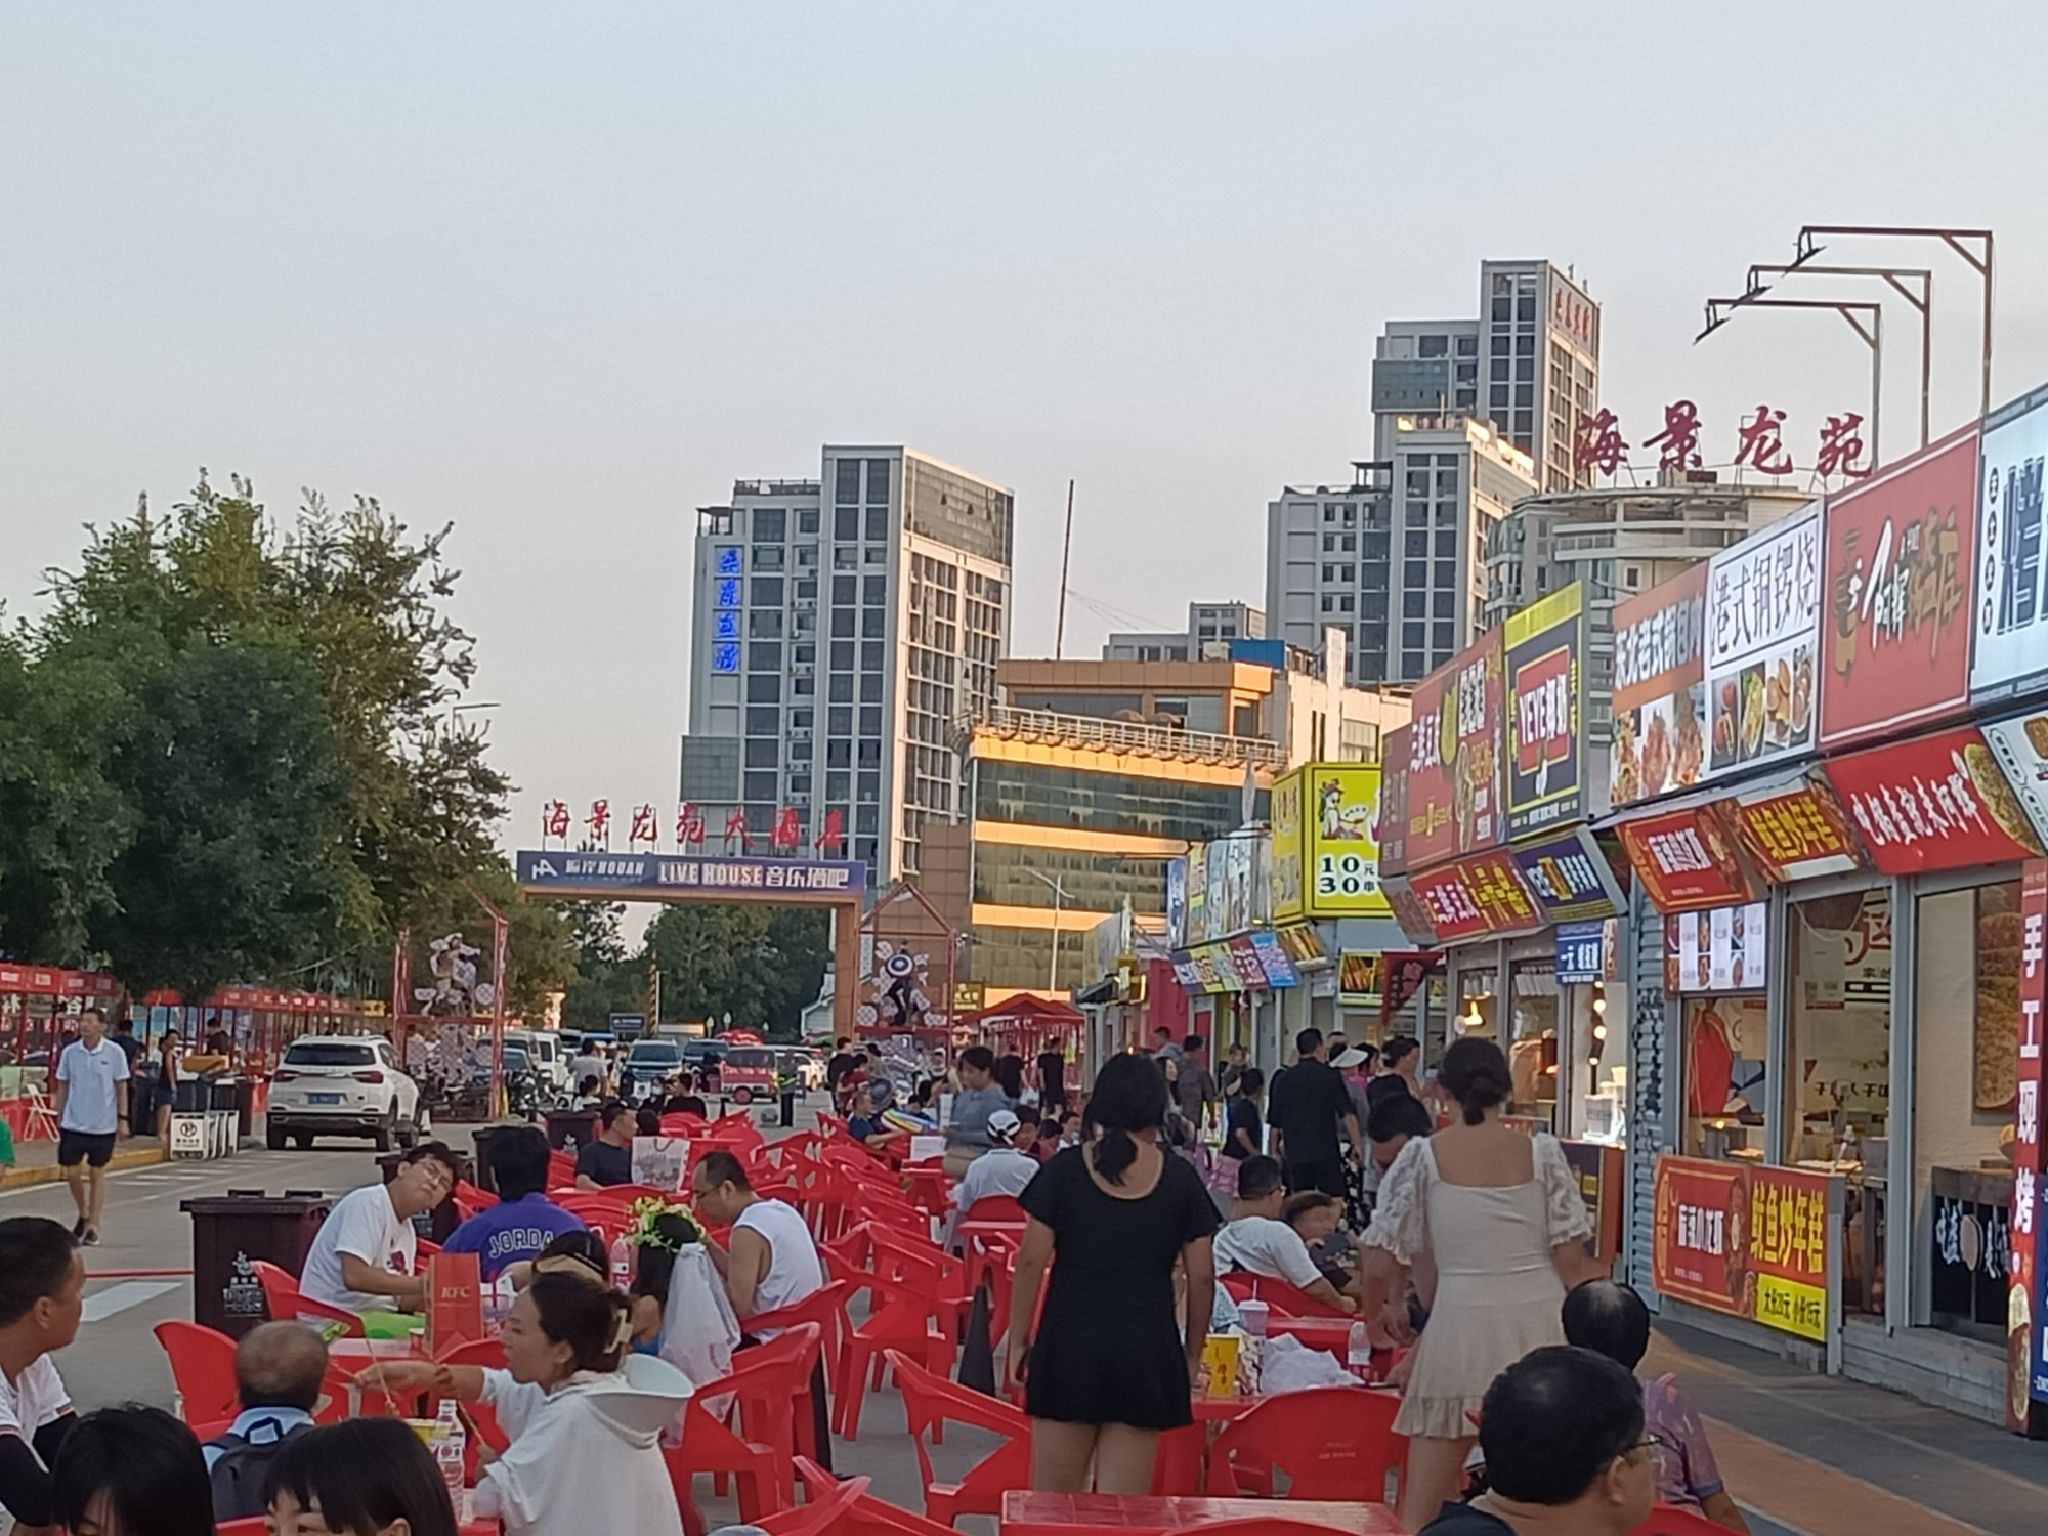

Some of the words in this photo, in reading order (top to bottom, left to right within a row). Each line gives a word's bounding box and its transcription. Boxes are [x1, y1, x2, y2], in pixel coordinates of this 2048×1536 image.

[1573, 400, 1872, 477] 海景龙苑
[1709, 531, 1814, 656] 港式铜锣烧
[543, 799, 844, 850] 海景龙苑大酒店
[1749, 796, 1841, 859] 鱿鱼炒年糕
[658, 862, 698, 884] LIVE
[701, 863, 763, 886] HOUSE
[765, 866, 849, 889] 音乐酒吧
[1321, 856, 1375, 876] 10元
[1751, 1181, 1824, 1274] 鱿鱼炒年糕
[442, 1286, 471, 1299] KFC
